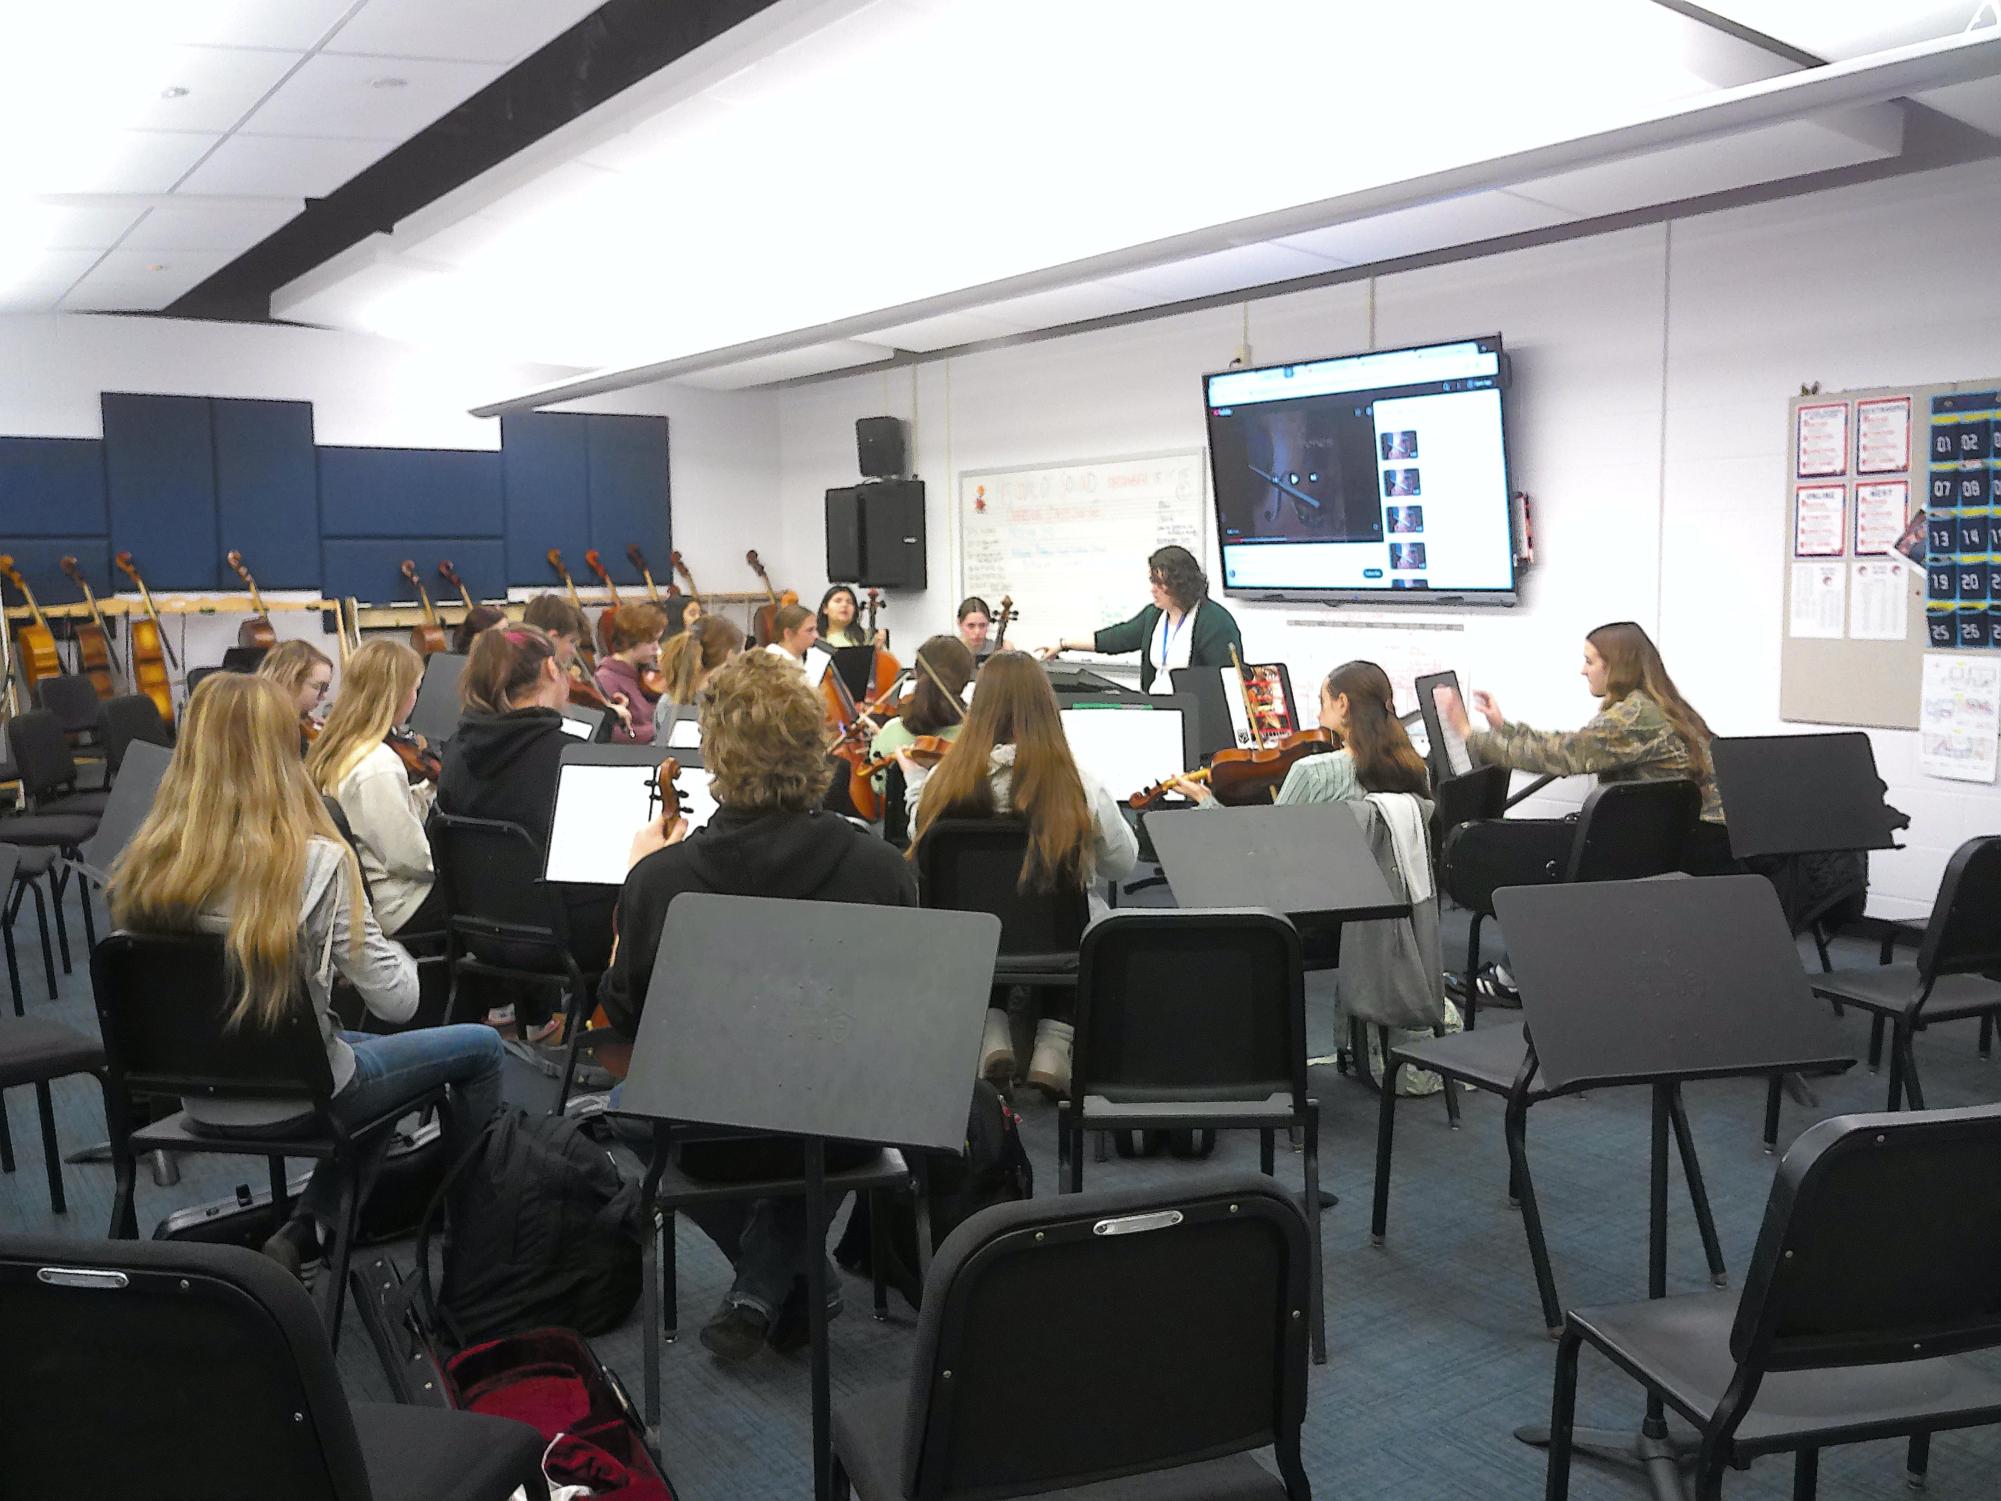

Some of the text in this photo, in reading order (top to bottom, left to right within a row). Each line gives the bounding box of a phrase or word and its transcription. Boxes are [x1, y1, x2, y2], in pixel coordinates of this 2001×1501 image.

[1960, 433, 1979, 451] 02
[1934, 480, 1951, 497] 07
[1962, 479, 1980, 497] 08
[1932, 530, 1950, 547] 13
[1962, 528, 1980, 545] 14
[1932, 573, 1949, 590] 19
[1961, 573, 1979, 590] 20
[1931, 624, 1950, 640] 25
[1960, 623, 1980, 639] 26
